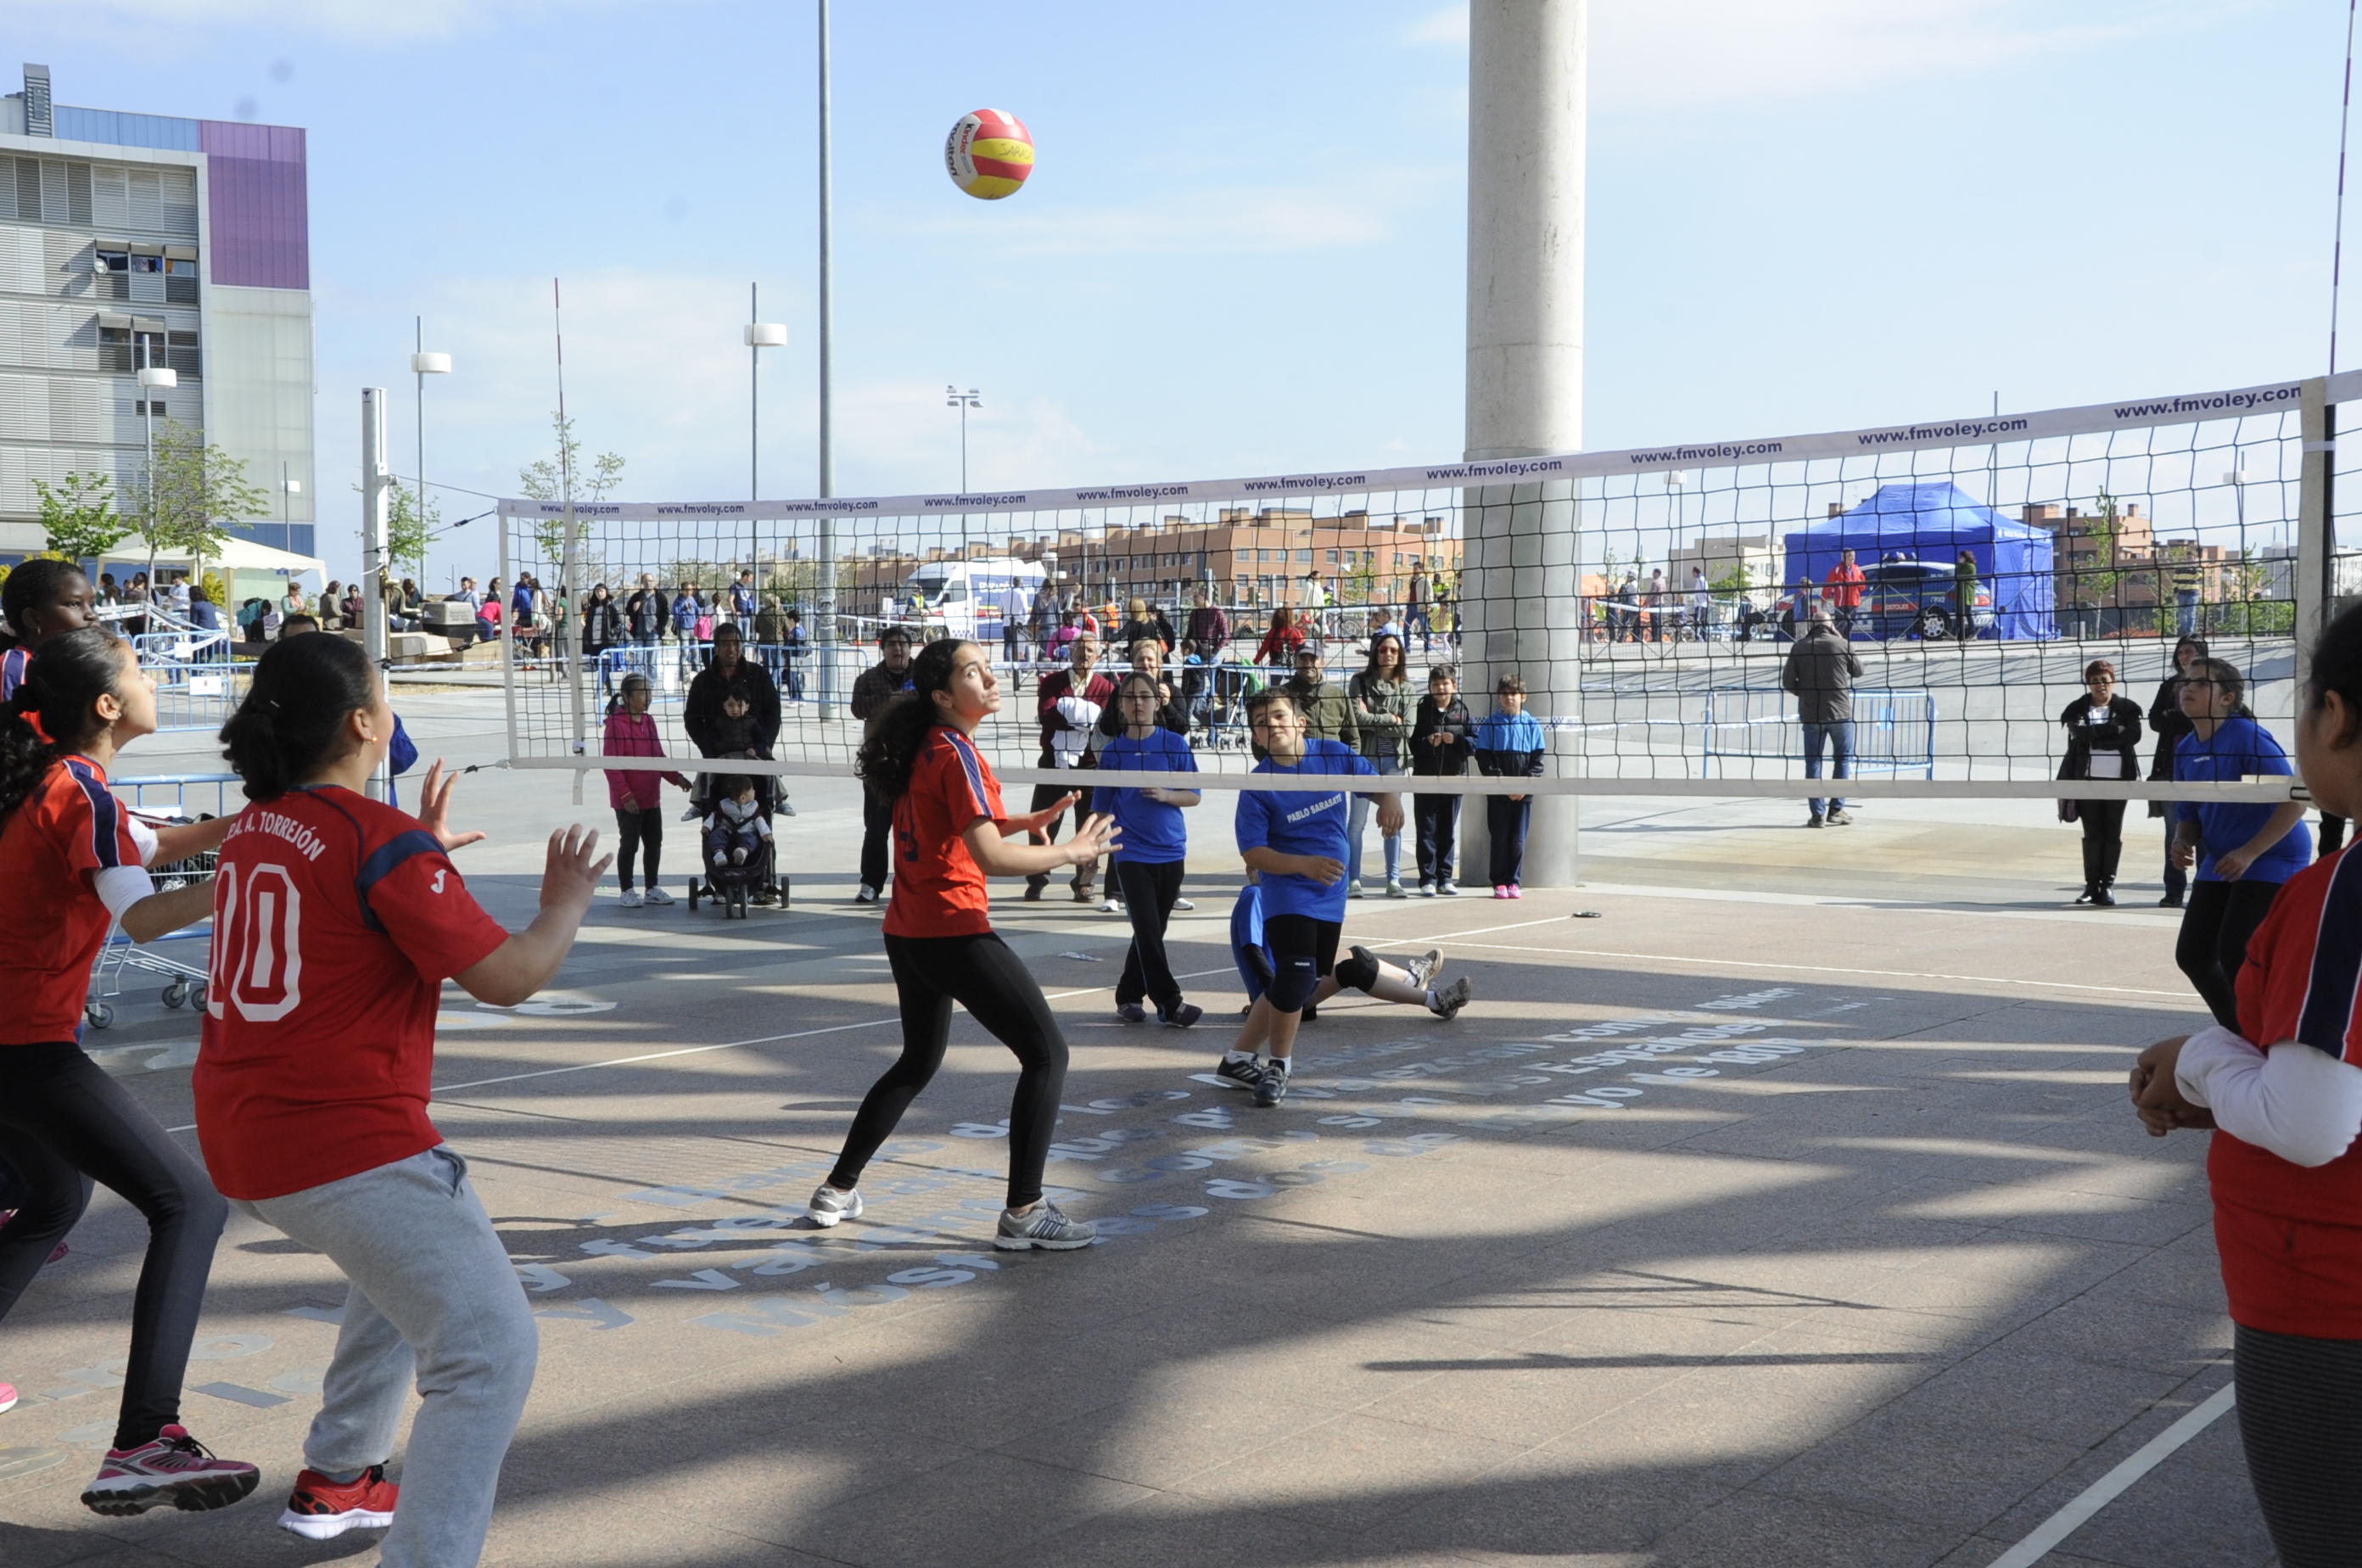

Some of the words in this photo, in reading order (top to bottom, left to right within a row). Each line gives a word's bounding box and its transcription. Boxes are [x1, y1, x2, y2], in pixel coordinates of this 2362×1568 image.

[1858, 416, 2029, 445] www.fmvoley.com
[1630, 440, 1783, 464] www.fmvoley.com
[1426, 458, 1563, 481] www.fmvoley.com
[1244, 473, 1366, 492] www.fmvoley.com
[924, 493, 1027, 508] www.fmvoley.com
[1076, 484, 1189, 501] www.fmvoley.com
[540, 504, 619, 516] www.voley.com
[657, 503, 745, 515] www.fmvoley.com
[786, 499, 878, 512] www.fmvoley.com
[1287, 808, 1310, 823] PABLO
[260, 810, 326, 862] TORREJÓN
[1316, 1095, 1459, 1129] son
[1519, 1017, 1787, 1075] Españoles
[1206, 1159, 1371, 1201] dos
[1363, 1130, 1472, 1158] de
[1628, 1058, 1721, 1087] de
